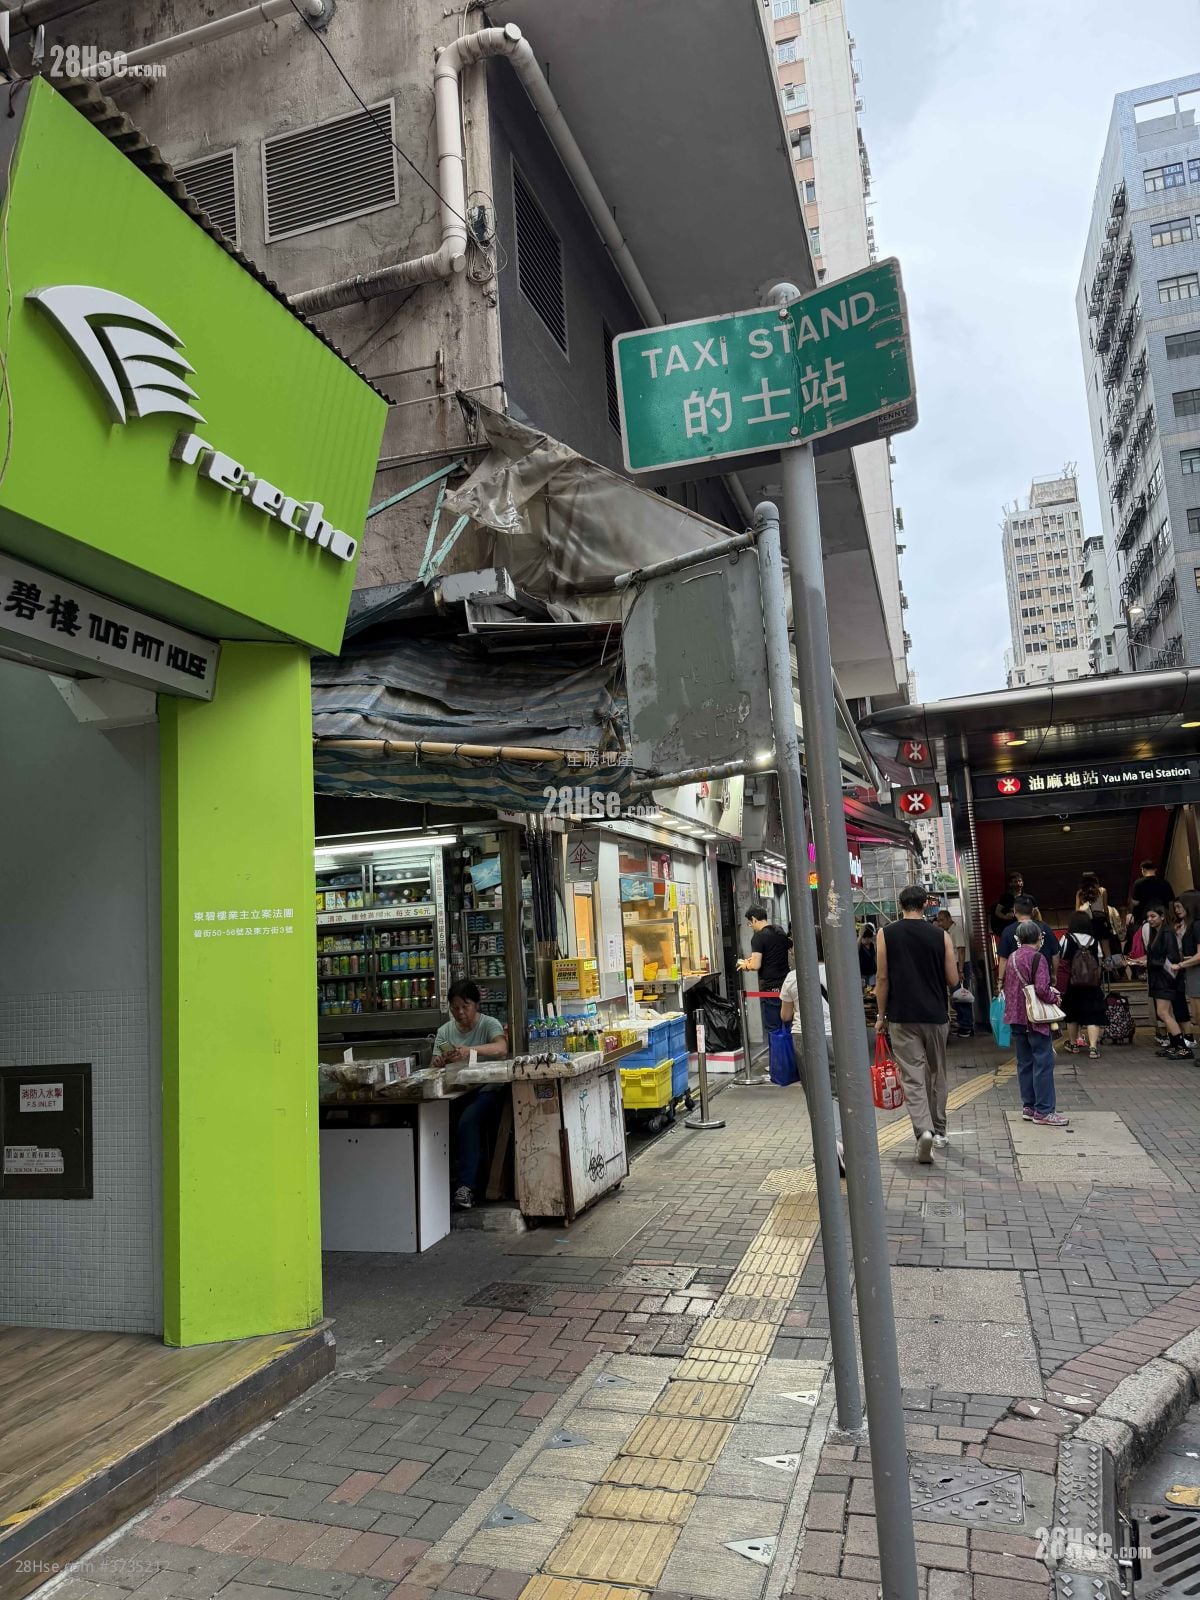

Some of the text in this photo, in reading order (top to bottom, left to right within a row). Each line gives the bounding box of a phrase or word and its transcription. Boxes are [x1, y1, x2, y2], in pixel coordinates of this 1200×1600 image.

[641, 291, 876, 379] TAXI STAND
[682, 356, 848, 439] 的士站
[879, 408, 907, 422] KENNY
[89, 612, 207, 680] TUNG PITT HOUSE
[1028, 767, 1191, 791] 油麻地站 Yau Ma Tei Station
[193, 908, 294, 922] 東碧樓業主立案法團
